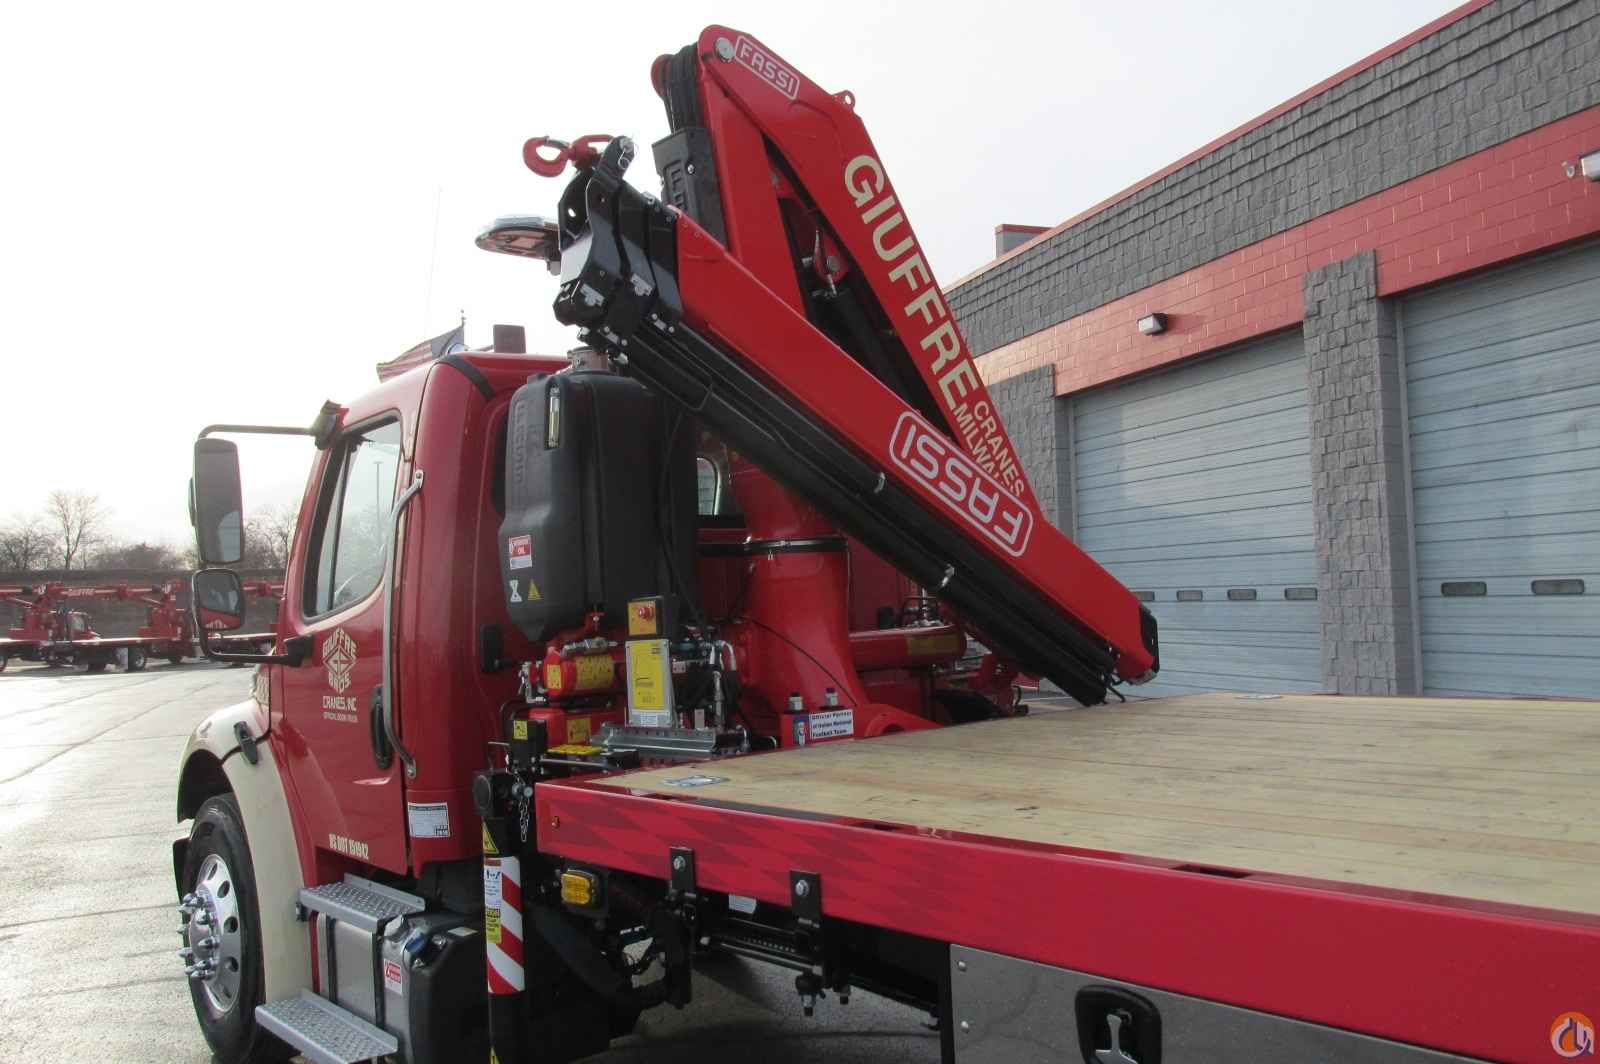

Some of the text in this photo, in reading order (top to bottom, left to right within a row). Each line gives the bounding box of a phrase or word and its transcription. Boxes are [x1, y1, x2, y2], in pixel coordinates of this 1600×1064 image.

[740, 43, 794, 93] FASSI
[844, 154, 980, 411] GIUFFRE
[900, 423, 1024, 546] FASSI
[953, 402, 1002, 482] MILWA
[973, 400, 1025, 497] CRANES
